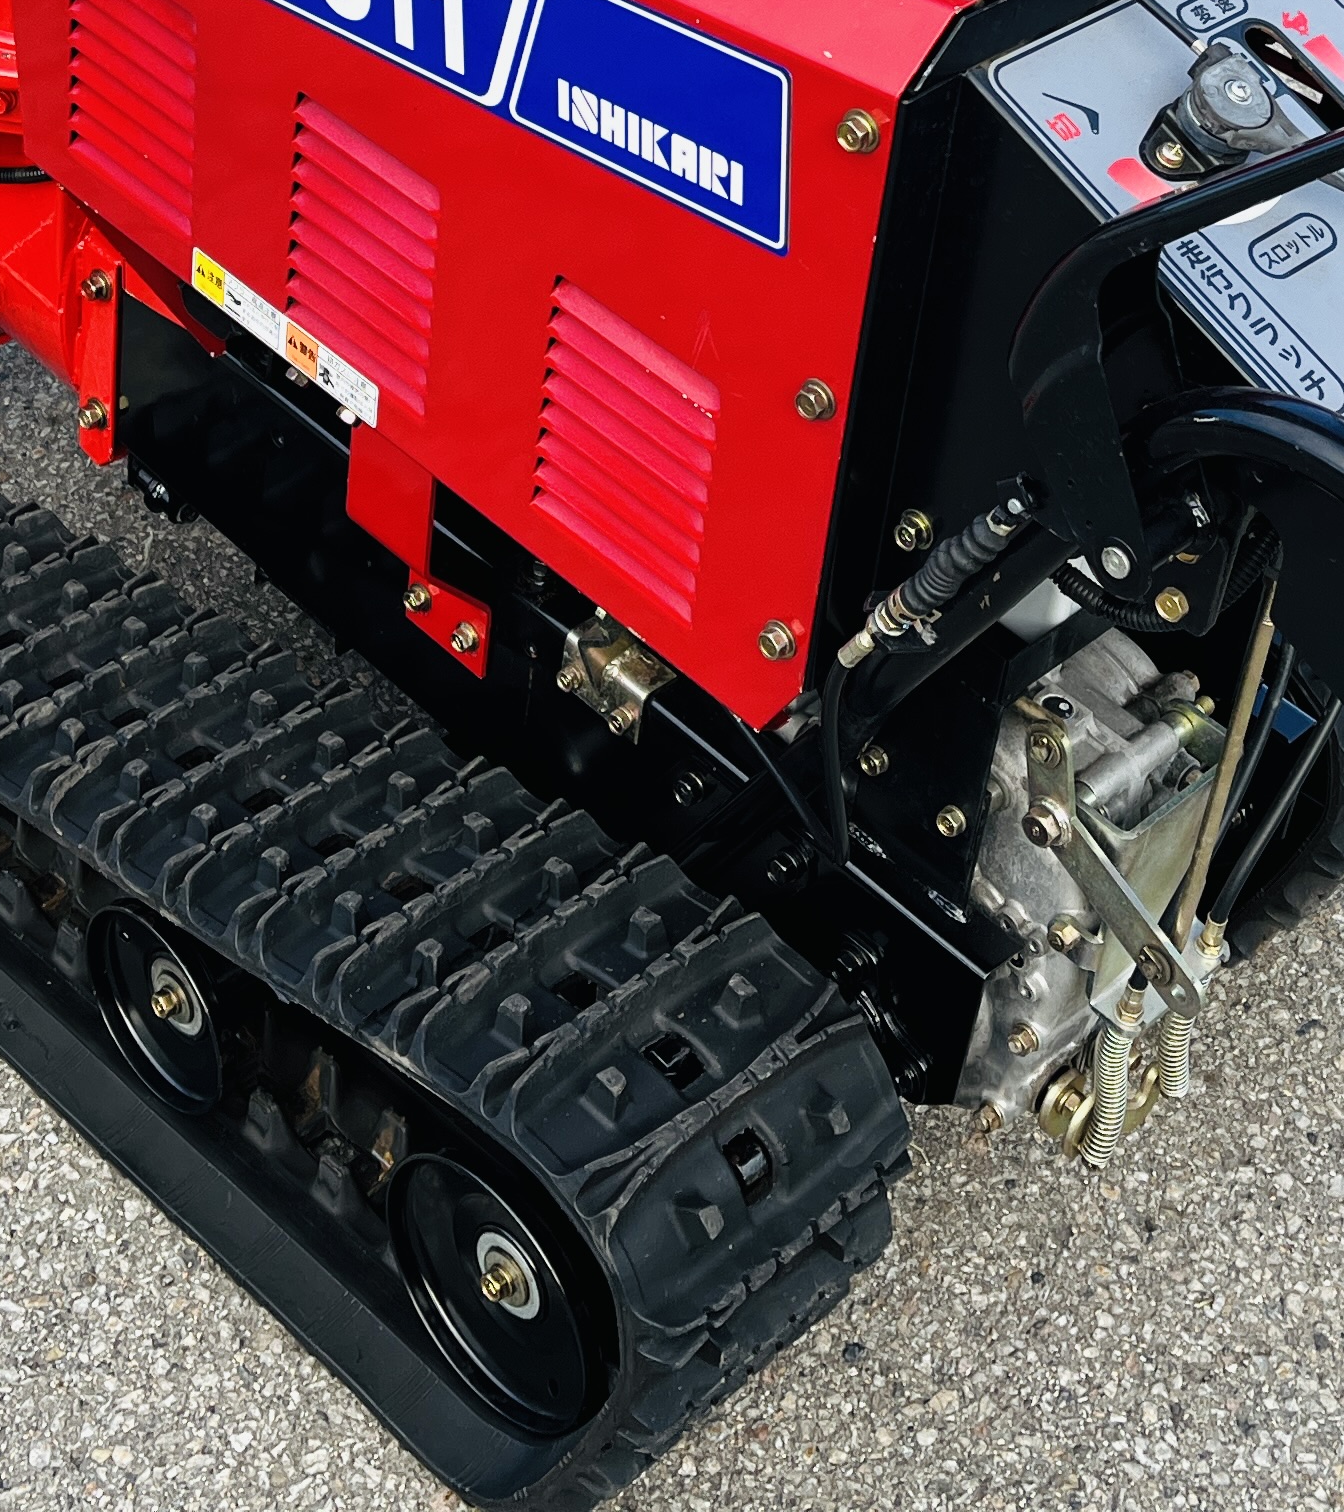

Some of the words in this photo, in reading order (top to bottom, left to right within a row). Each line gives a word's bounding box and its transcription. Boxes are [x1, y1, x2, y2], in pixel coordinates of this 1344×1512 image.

[557, 78, 744, 208] ISHIKARI
[1045, 112, 1082, 141] 切
[1258, 223, 1325, 270] スロットル
[1175, 239, 1326, 401] 走行クラッチ
